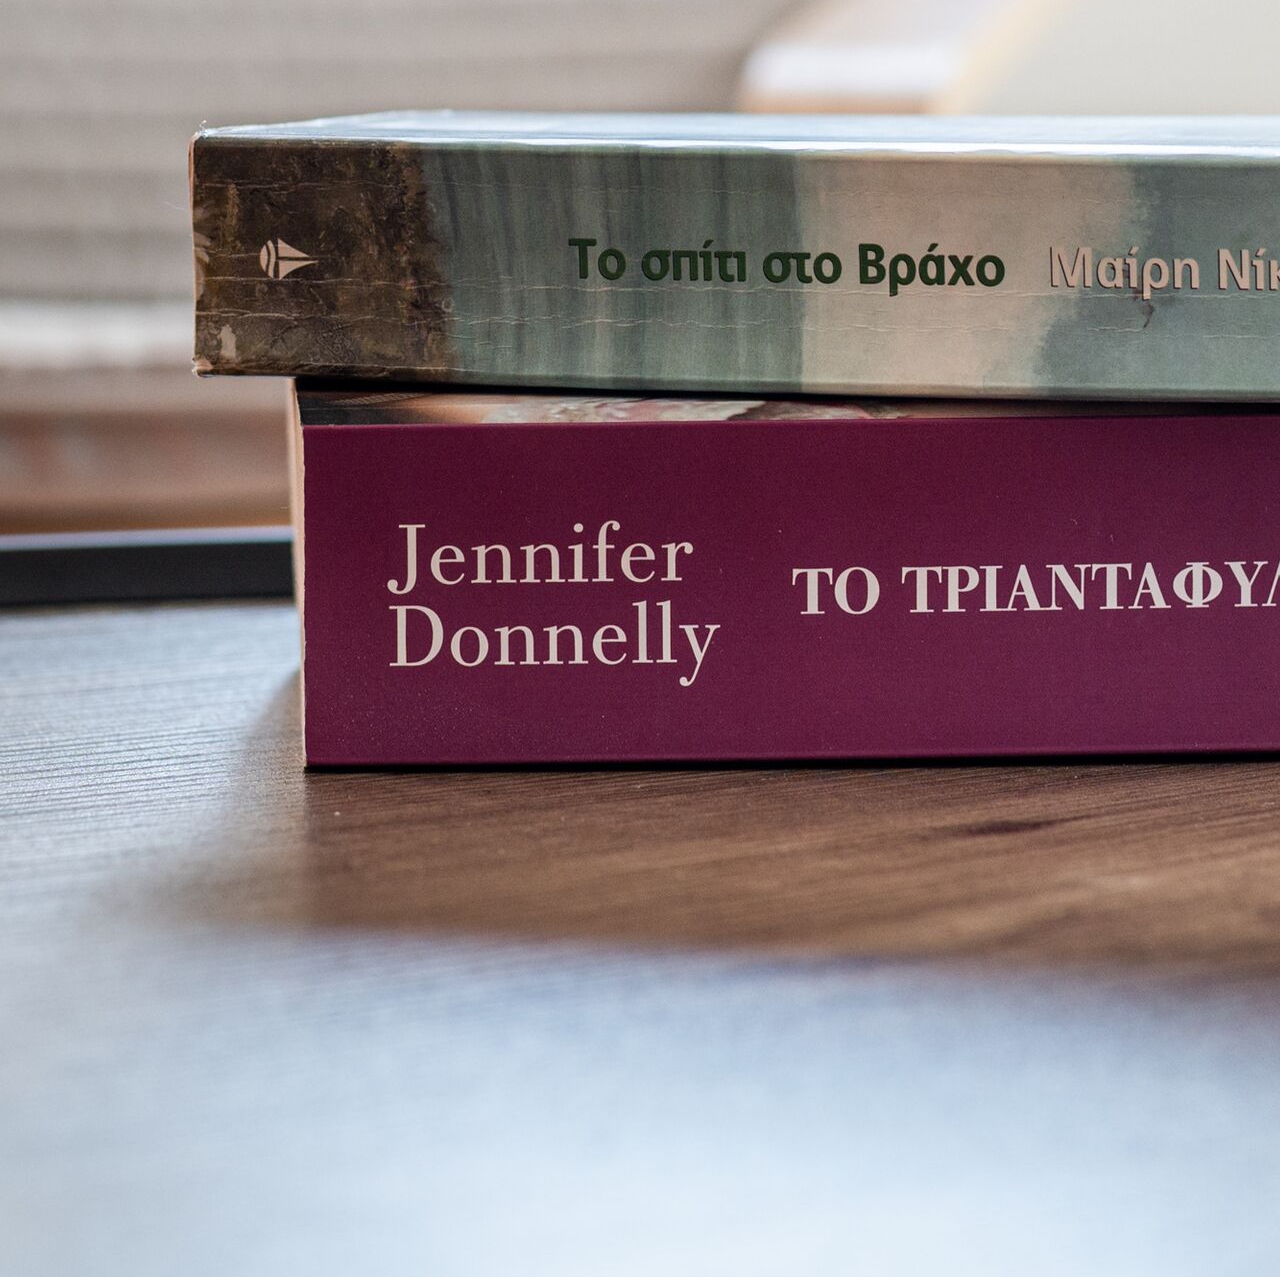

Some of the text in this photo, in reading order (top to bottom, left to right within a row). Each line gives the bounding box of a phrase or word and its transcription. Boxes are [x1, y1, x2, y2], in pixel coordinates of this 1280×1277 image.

[568, 237, 1006, 297] Το σπίτι στο Βράχο
[1049, 245, 1200, 300] Μαίρη
[386, 520, 695, 595] Jennifer
[792, 565, 881, 615] ΤΟ
[388, 599, 721, 687] Donnelly
